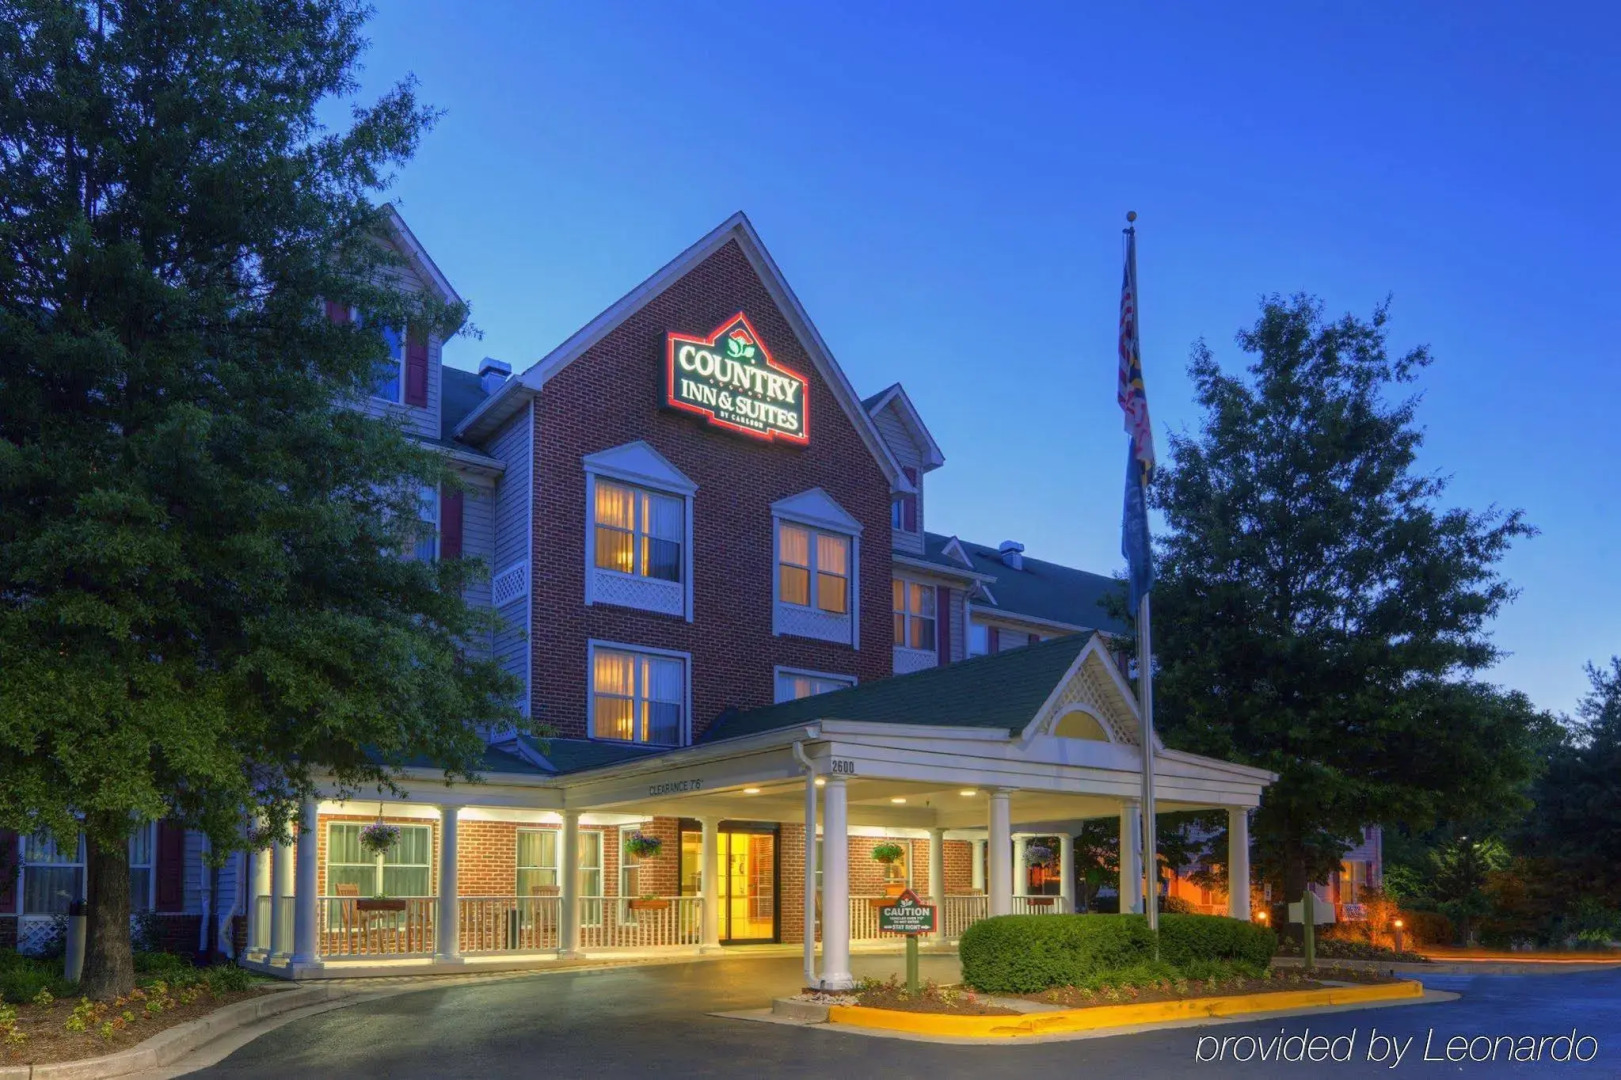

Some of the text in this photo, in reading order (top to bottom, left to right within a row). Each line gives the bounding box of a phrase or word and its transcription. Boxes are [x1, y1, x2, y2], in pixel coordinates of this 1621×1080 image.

[679, 345, 799, 403] COUNTRY
[681, 378, 798, 430] INN & SUITES
[720, 410, 729, 419] BY
[832, 760, 854, 774] 2600
[649, 780, 689, 796] CLEARANCE
[884, 907, 930, 916] CAUTION
